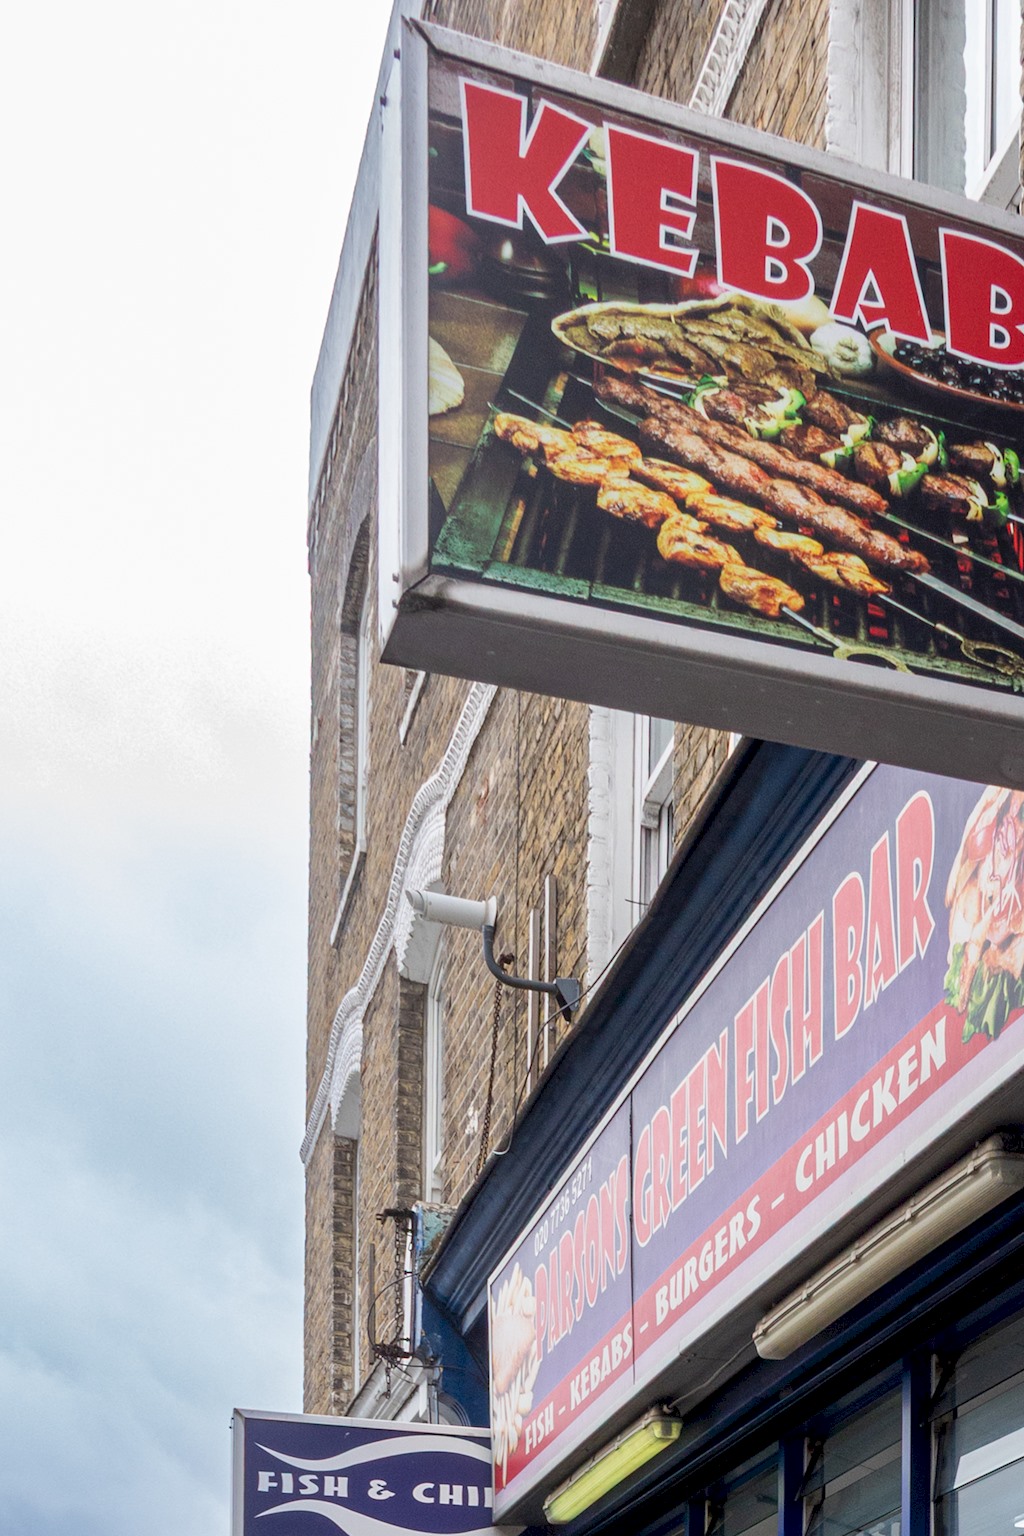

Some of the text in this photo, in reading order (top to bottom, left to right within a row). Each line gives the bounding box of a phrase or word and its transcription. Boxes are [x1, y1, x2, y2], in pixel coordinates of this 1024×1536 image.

[534, 789, 936, 1362] PARSONS GREEN FISH BAR
[534, 1156, 592, 1257] 020 7736 5271
[524, 1414, 555, 1455] FISH
[569, 1320, 633, 1412] KEBABS
[654, 1194, 762, 1327] BURGERS
[795, 1015, 948, 1192] CHICKEN
[257, 1470, 349, 1498] FISH
[367, 1479, 396, 1500] &
